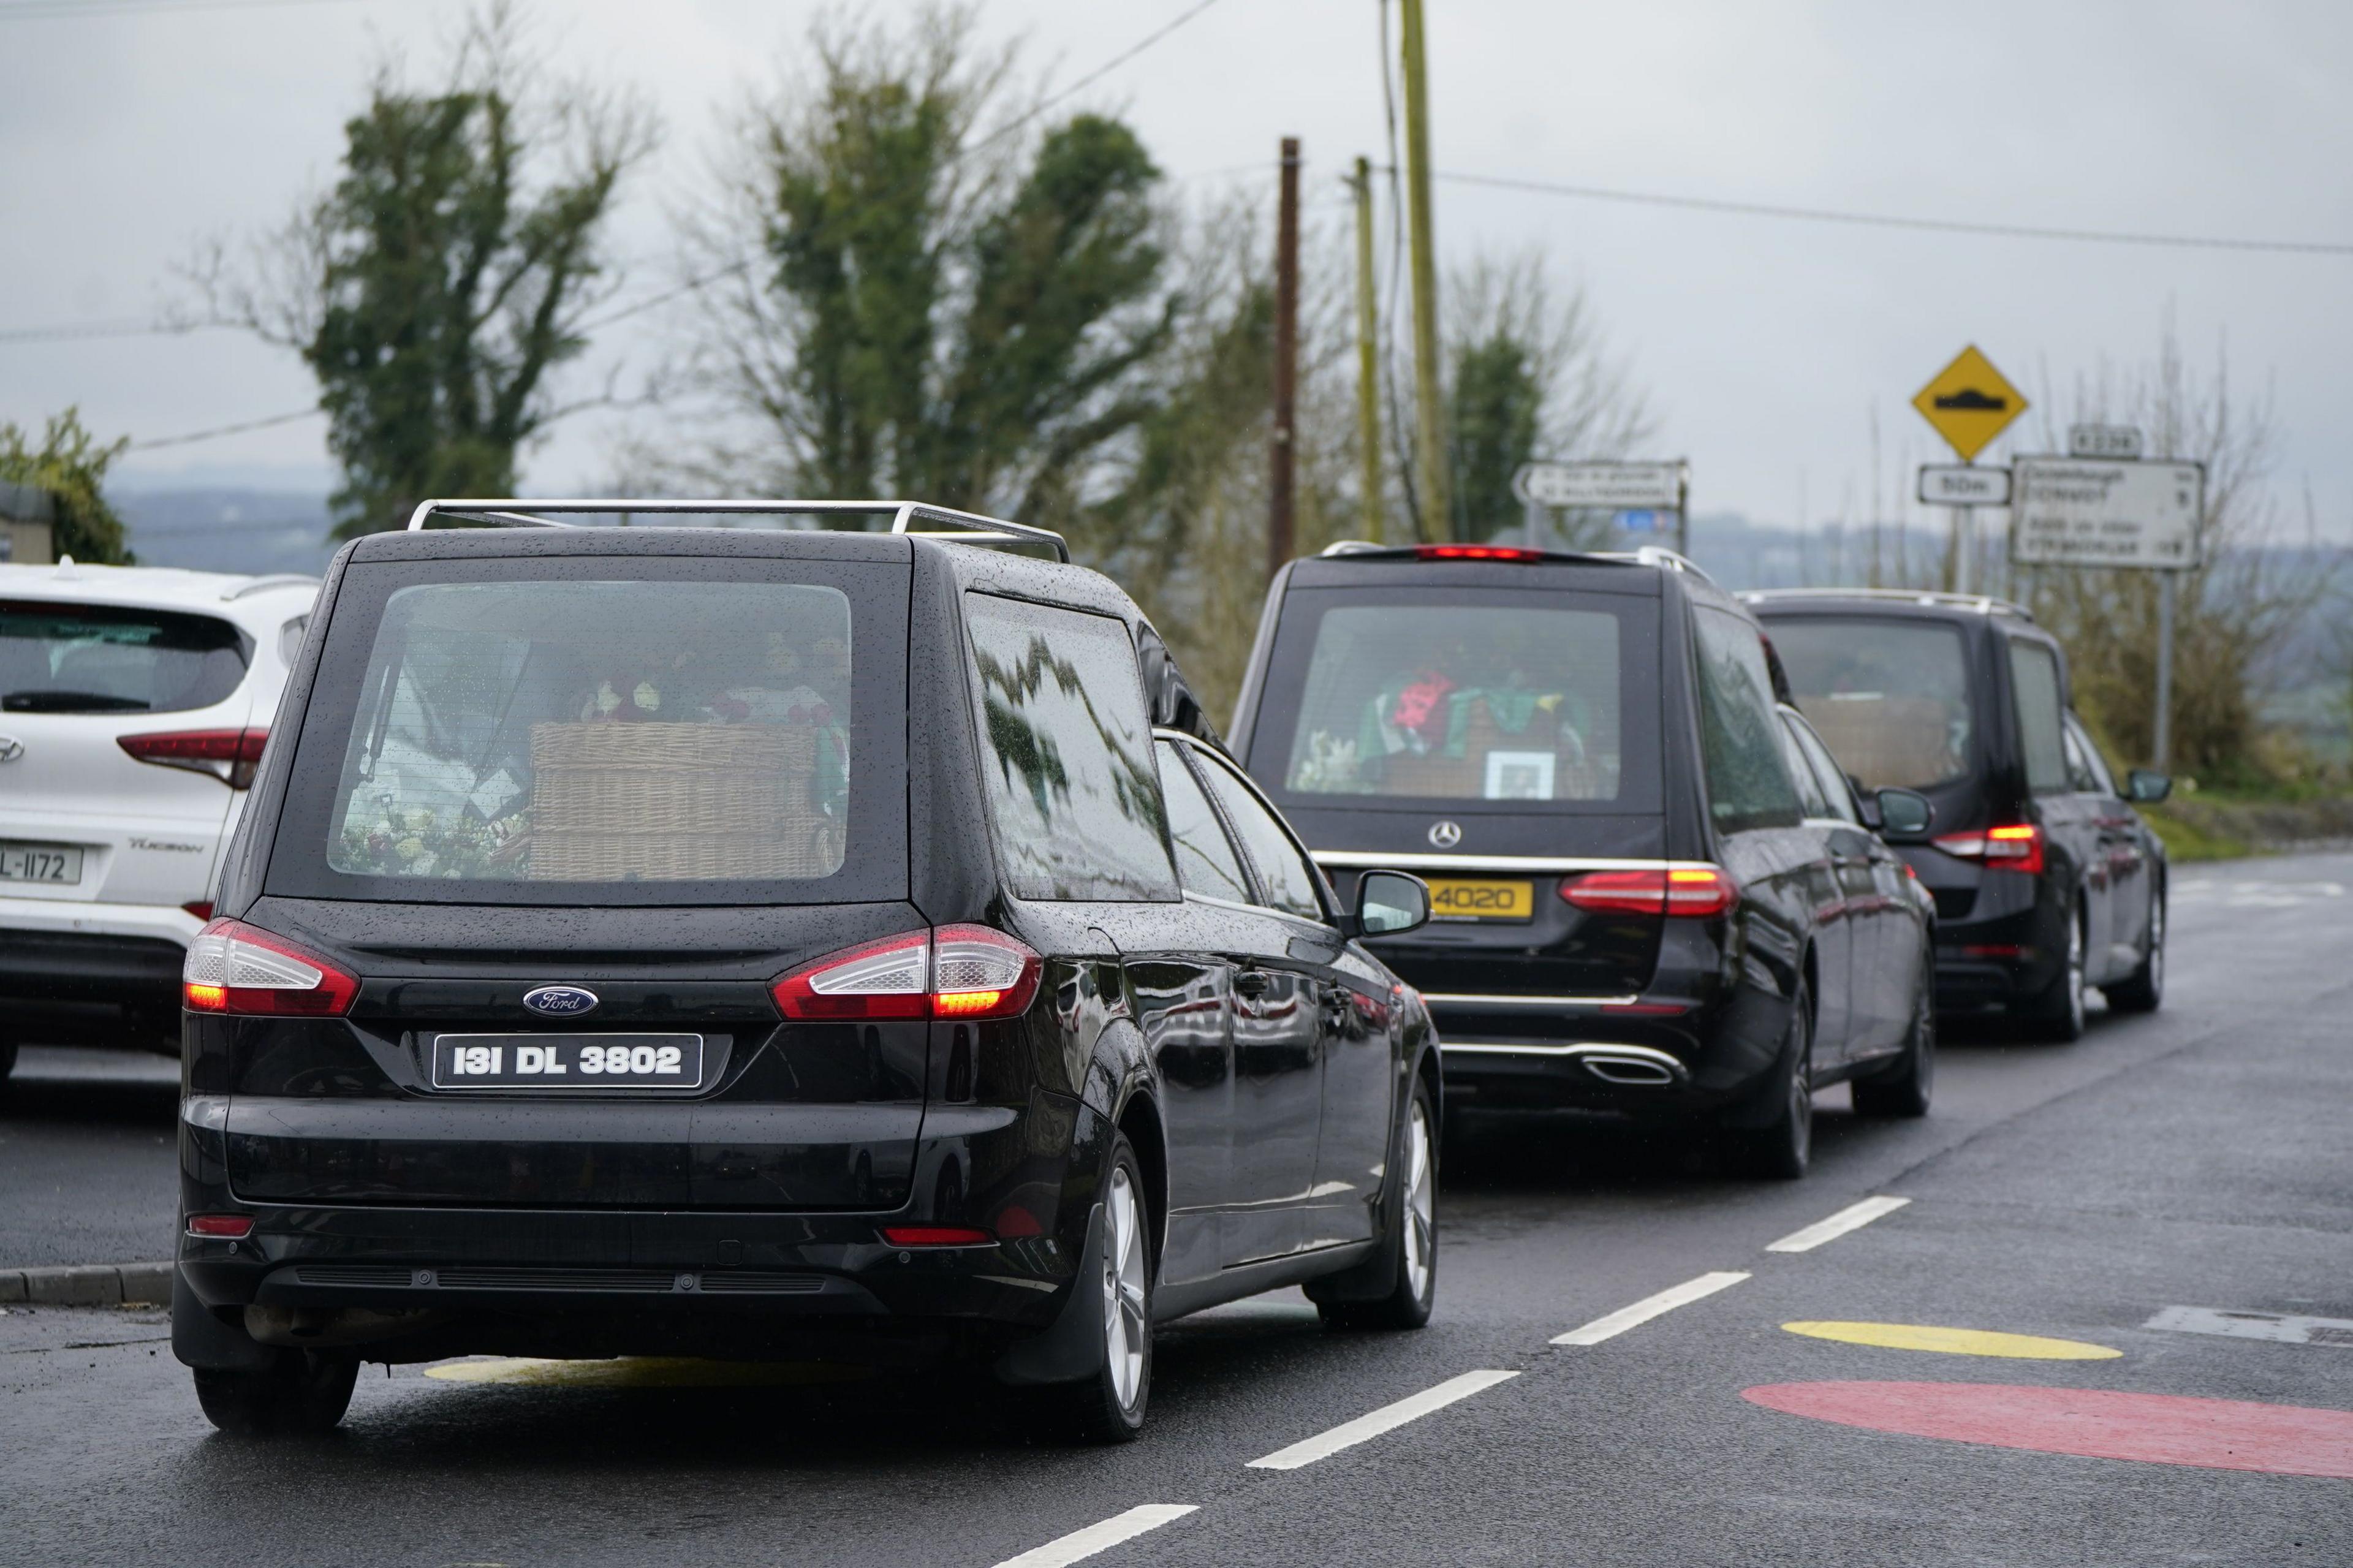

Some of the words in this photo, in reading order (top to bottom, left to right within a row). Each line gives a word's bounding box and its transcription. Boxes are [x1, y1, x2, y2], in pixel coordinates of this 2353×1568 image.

[1434, 887, 1515, 909] 4020
[539, 991, 580, 1010] Ford
[516, 1047, 567, 1074] DL
[579, 1046, 681, 1074] 3802
